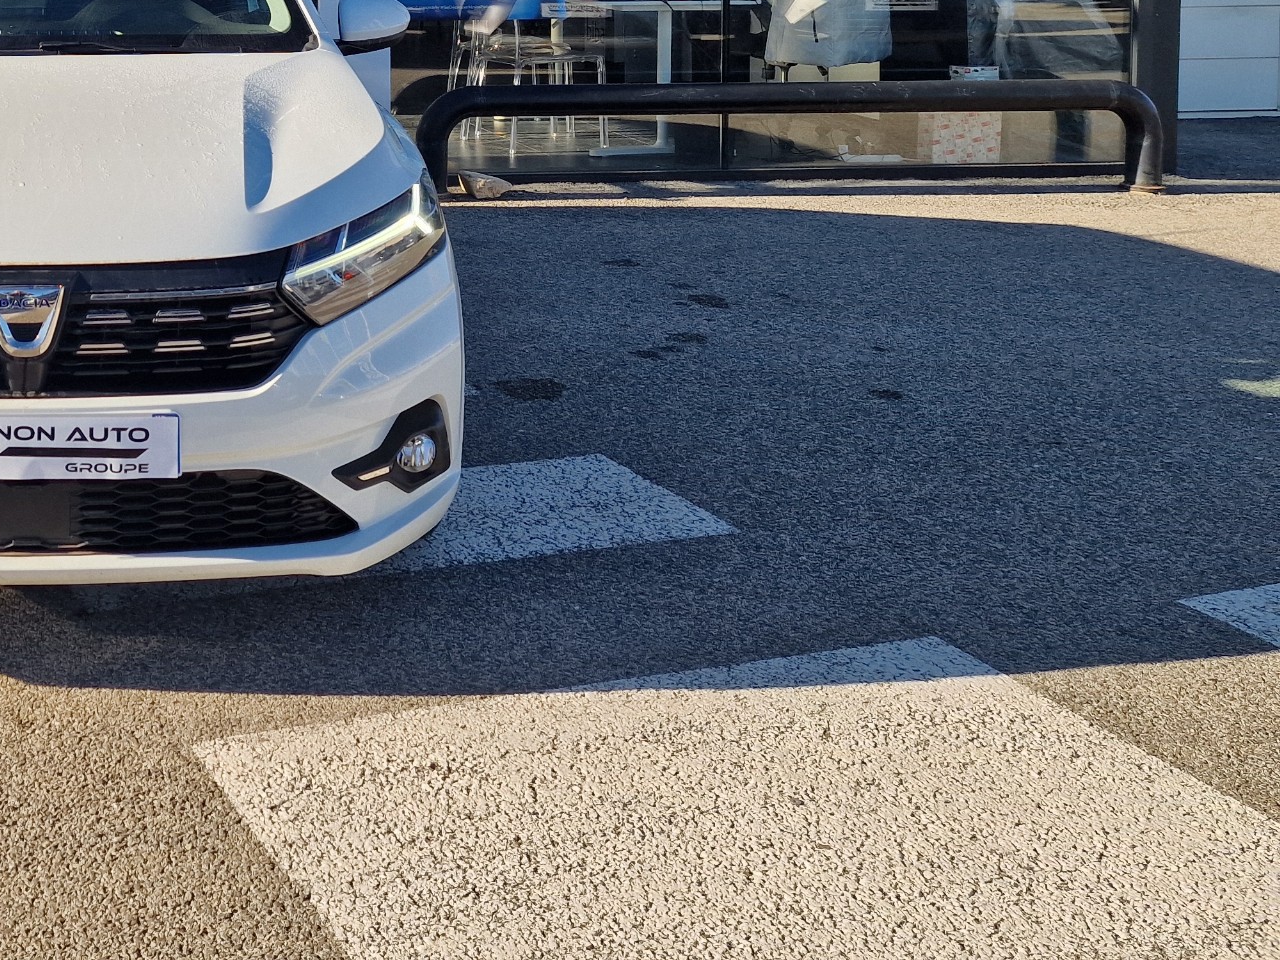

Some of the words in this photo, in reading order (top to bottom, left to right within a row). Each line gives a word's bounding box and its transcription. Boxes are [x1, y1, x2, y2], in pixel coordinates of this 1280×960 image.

[0, 298, 51, 308] DACIA
[65, 426, 151, 442] AUTO
[65, 462, 150, 474] GROUPE
